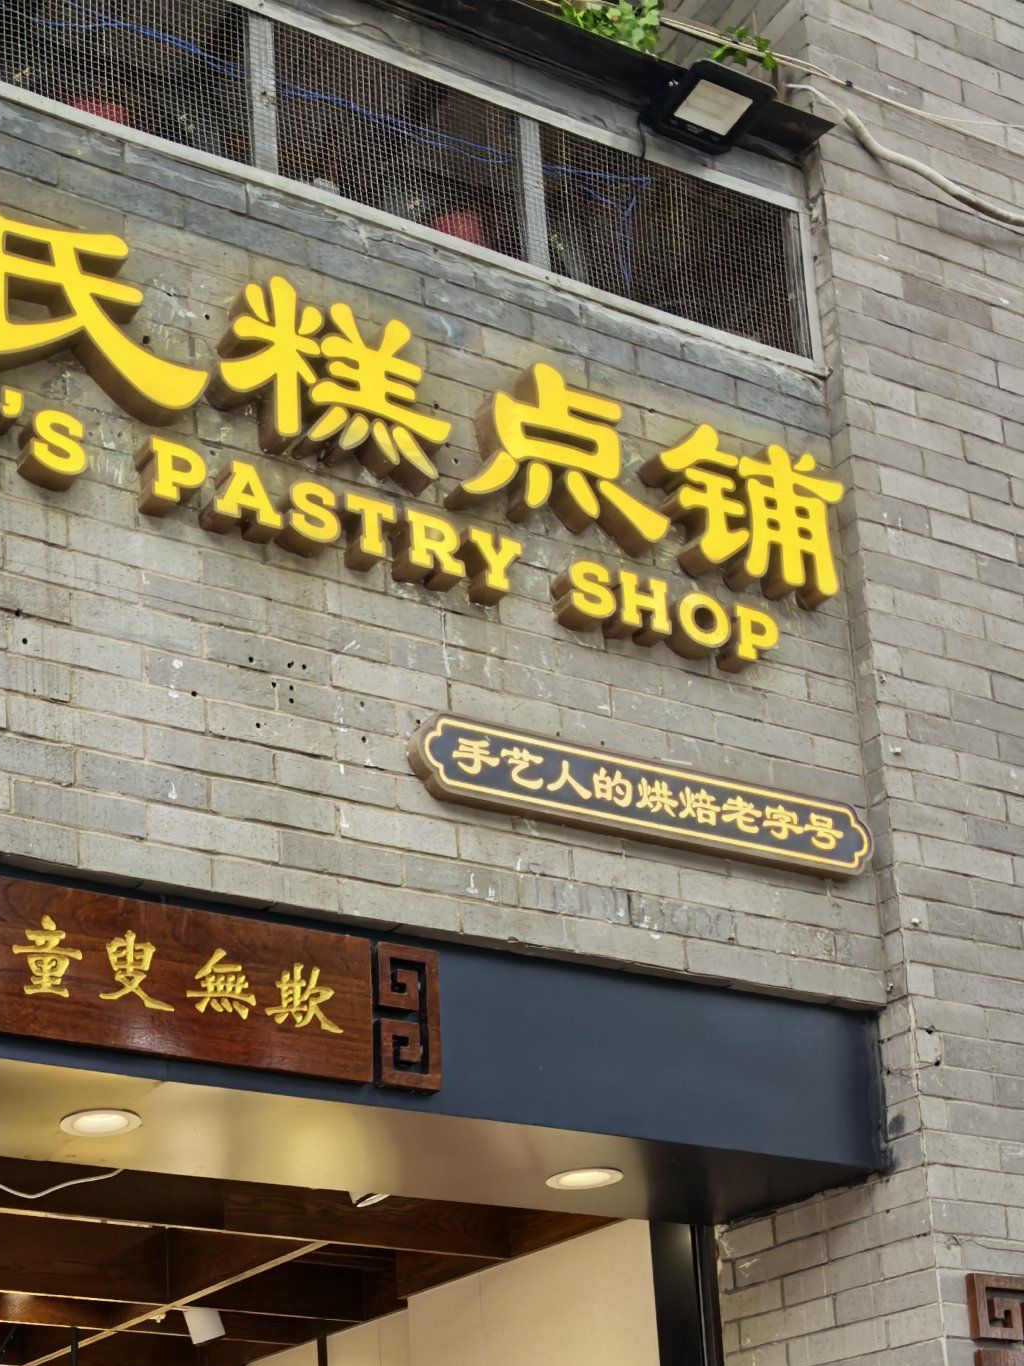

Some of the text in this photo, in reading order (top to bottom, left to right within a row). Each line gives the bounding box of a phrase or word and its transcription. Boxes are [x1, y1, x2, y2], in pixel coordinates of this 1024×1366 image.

[151, 438, 523, 592] PASTRY
[570, 560, 780, 662] SHOP
[452, 736, 844, 851] 手艺人的烘焙老字号
